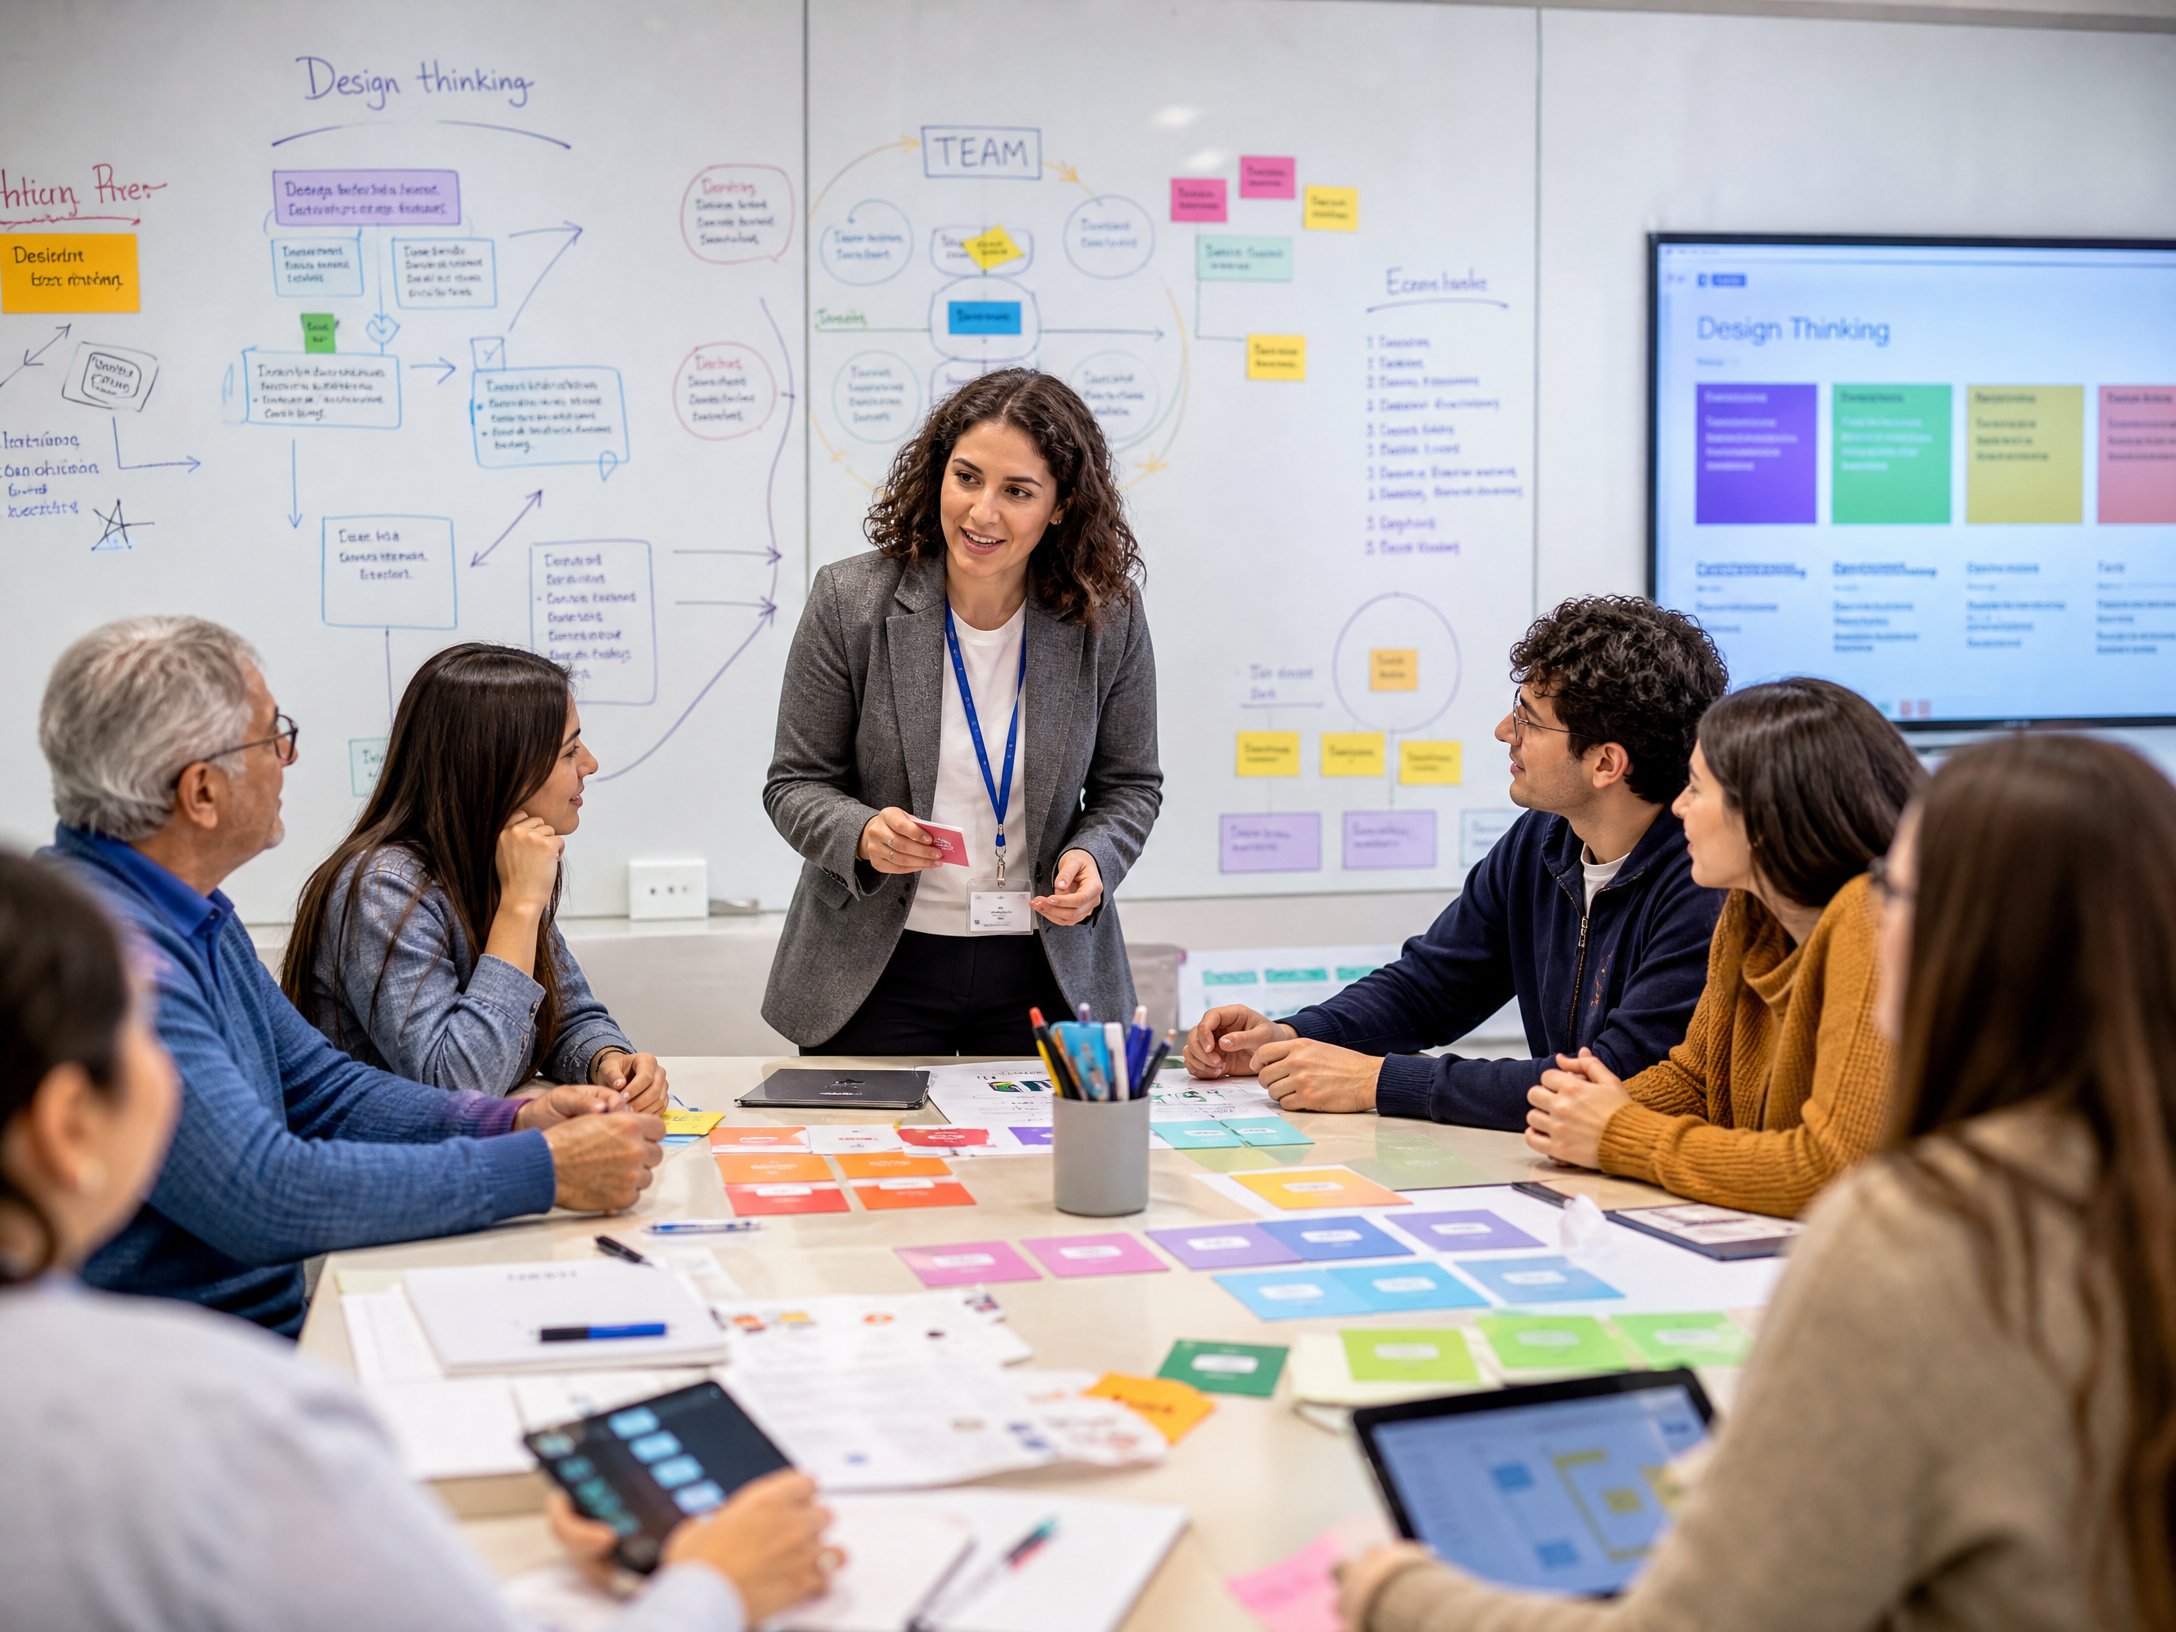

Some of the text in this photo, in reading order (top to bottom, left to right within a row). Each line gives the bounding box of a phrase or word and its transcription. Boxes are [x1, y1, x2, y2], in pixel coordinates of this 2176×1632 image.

[295, 55, 535, 111] Design thinking
[933, 136, 1030, 168] TEAM
[1697, 315, 1891, 348] Design Thinking
